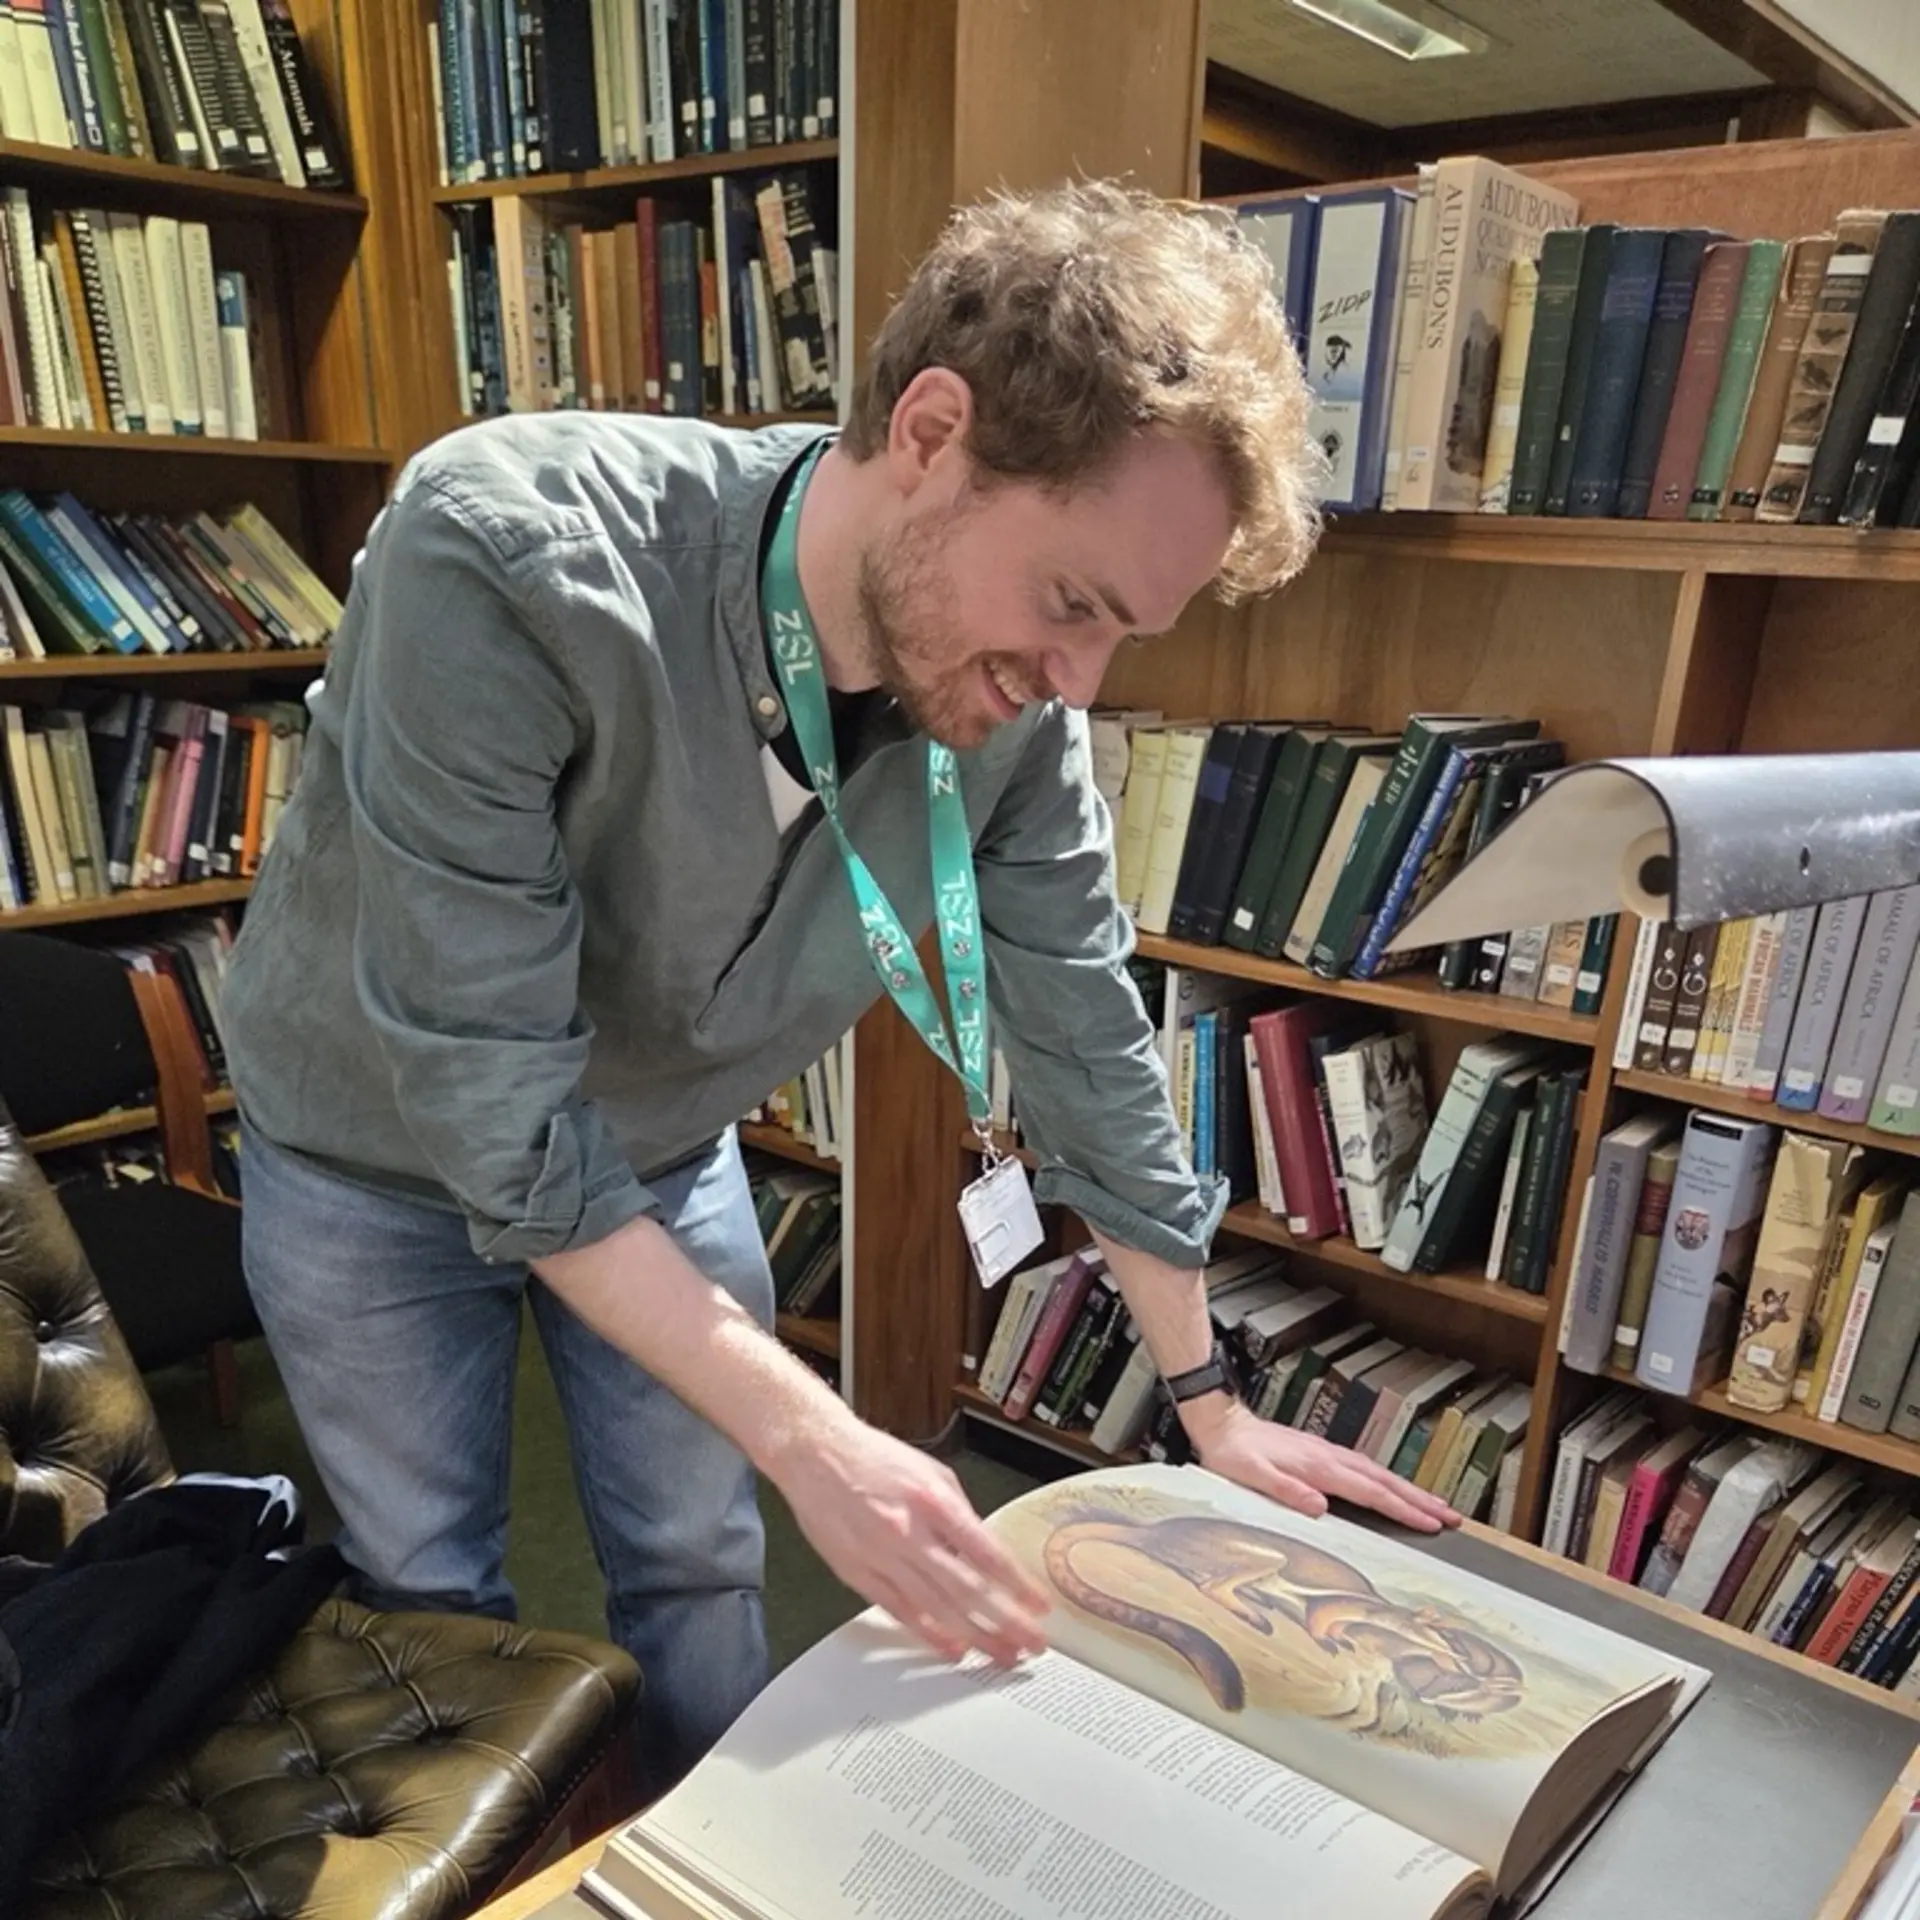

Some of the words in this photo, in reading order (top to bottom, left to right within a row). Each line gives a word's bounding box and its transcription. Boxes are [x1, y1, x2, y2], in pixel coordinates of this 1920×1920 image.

[280, 49, 314, 136] Mammals
[1428, 184, 1464, 350] AUDUBON'S
[774, 609, 814, 685] ZSL
[939, 870, 973, 938] ZSL
[859, 904, 904, 973] ZSL
[1824, 936, 1839, 954] OF
[1876, 946, 1891, 966] OF
[1777, 952, 1799, 999] AFRICA
[1811, 957, 1834, 1006] AFRICA
[1860, 969, 1884, 1019] AFRICA
[958, 1008, 984, 1073] ZSL
[1584, 1265, 1604, 1316] HARRIS
